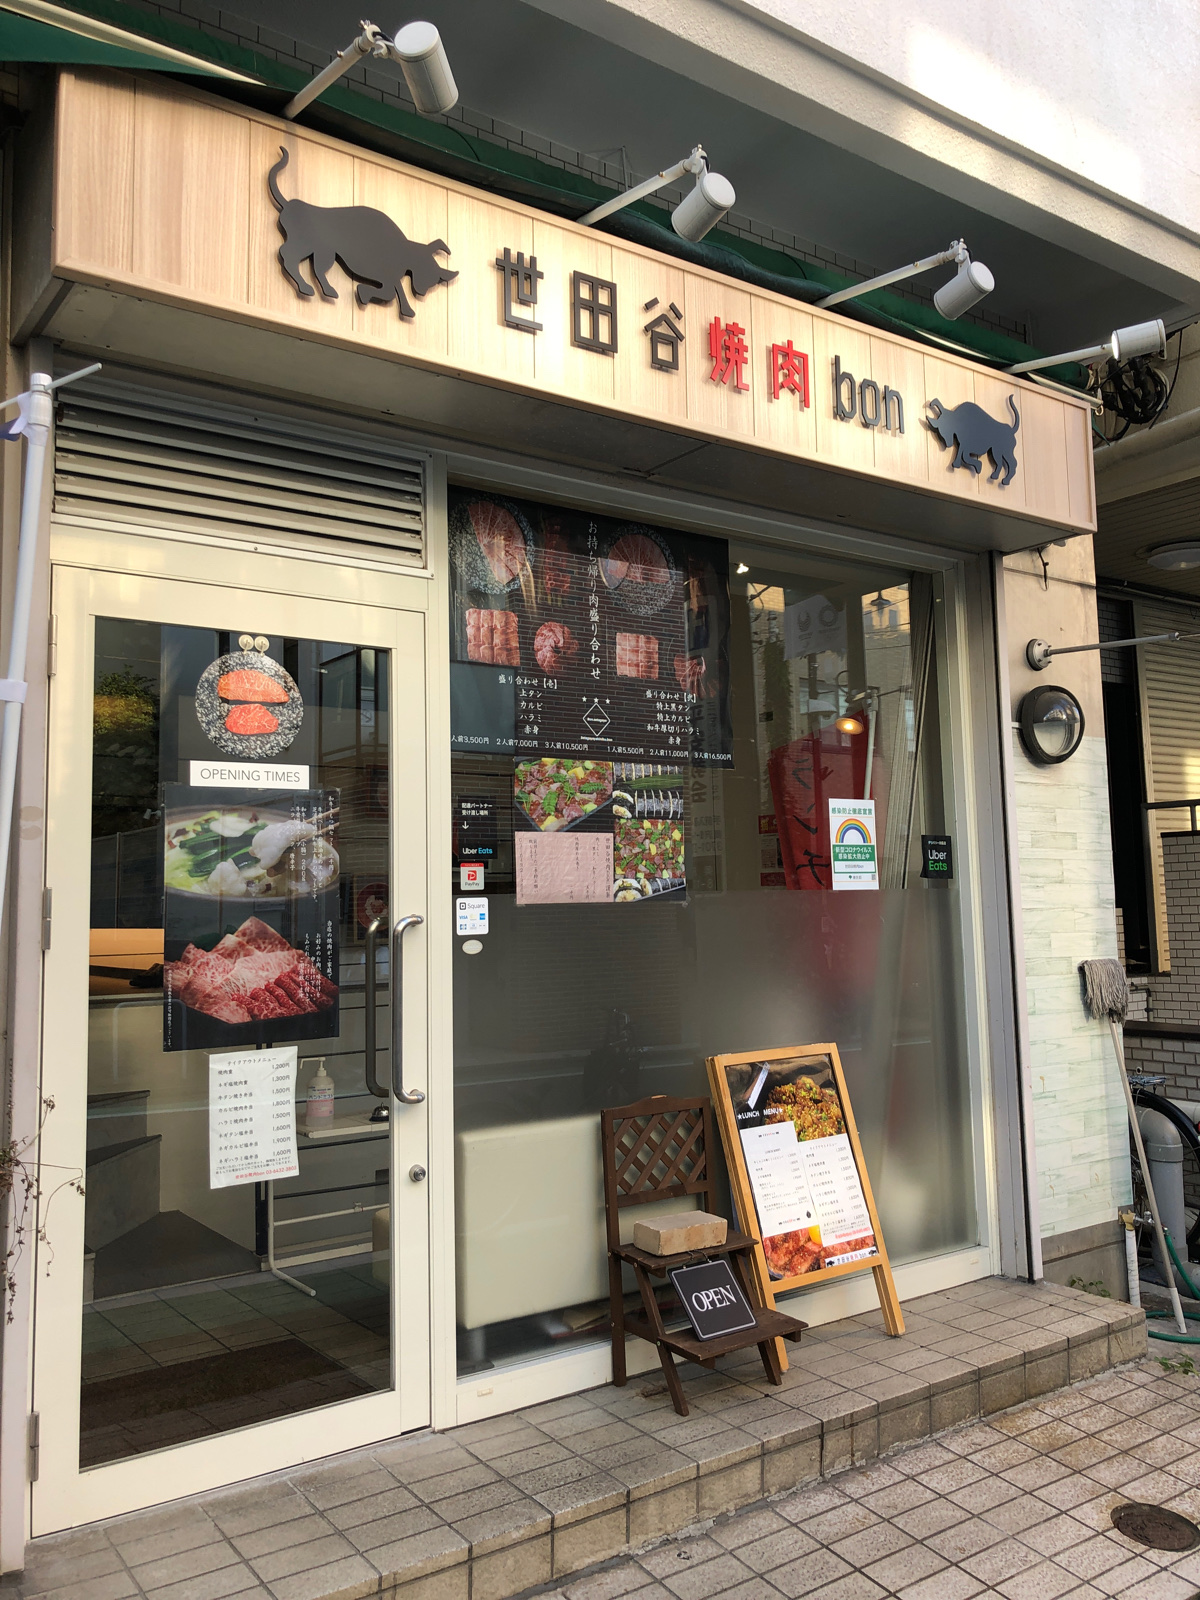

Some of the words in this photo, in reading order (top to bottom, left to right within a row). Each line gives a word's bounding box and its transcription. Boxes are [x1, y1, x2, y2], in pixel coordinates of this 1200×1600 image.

[587, 521, 601, 680] お持ち帰り肉盛り合わせ
[519, 688, 543, 698] 上タン
[520, 700, 544, 711] カルビ
[519, 713, 542, 723] ハラミ
[656, 712, 691, 724] 特上カルビ
[524, 724, 540, 735] 赤身
[668, 735, 682, 746] 赤身
[544, 741, 589, 751] 3人前10,500円
[200, 768, 261, 782] OPENING
[263, 770, 301, 783] TIMES
[832, 807, 873, 816] 感染防止徹底宣言
[462, 847, 478, 855] Uber
[478, 847, 493, 855] Eats
[928, 849, 947, 861] Uber
[928, 861, 948, 872] Eats
[227, 1057, 277, 1067] テイクアウトメニュー
[272, 1062, 290, 1070] 1,200円
[272, 1074, 290, 1082] 1,300円
[272, 1111, 291, 1119] 1,500円
[741, 1110, 760, 1120] LUNCH
[763, 1107, 779, 1117] MENU
[273, 1148, 291, 1156] 1,600円
[691, 1284, 737, 1312] OPEN
